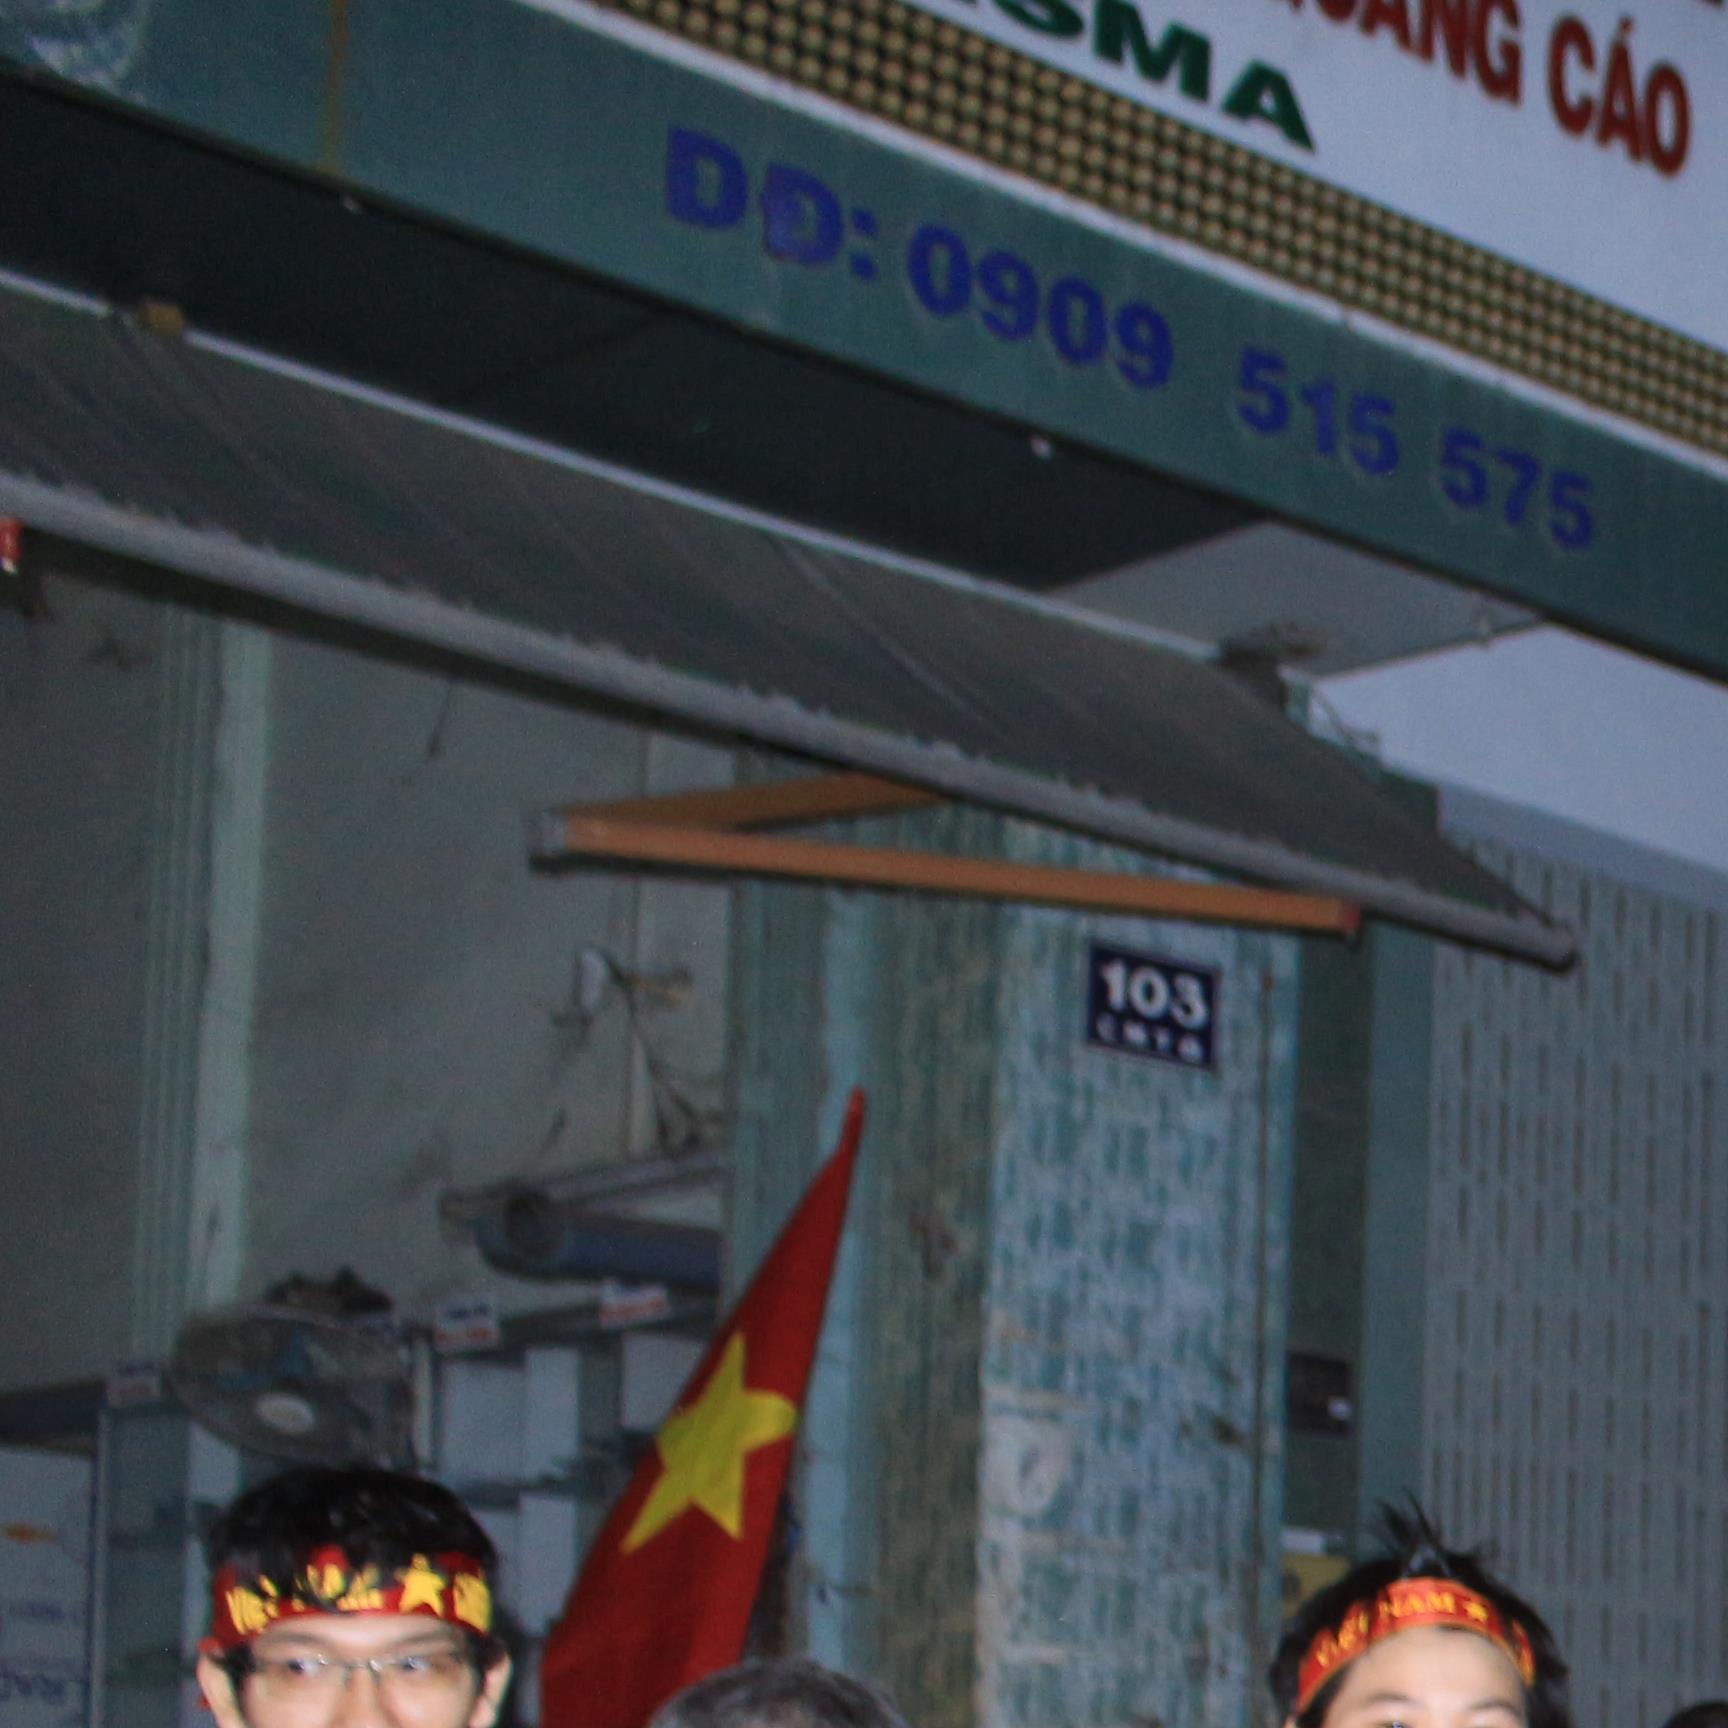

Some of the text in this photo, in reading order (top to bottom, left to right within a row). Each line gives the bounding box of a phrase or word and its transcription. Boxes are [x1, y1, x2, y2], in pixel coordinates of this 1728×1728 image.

[1548, 15, 1691, 177] CÁO
[908, 225, 1173, 389] 0909
[1238, 348, 1400, 478] 515
[1441, 428, 1595, 551] 575
[1097, 957, 1208, 1031] 103
